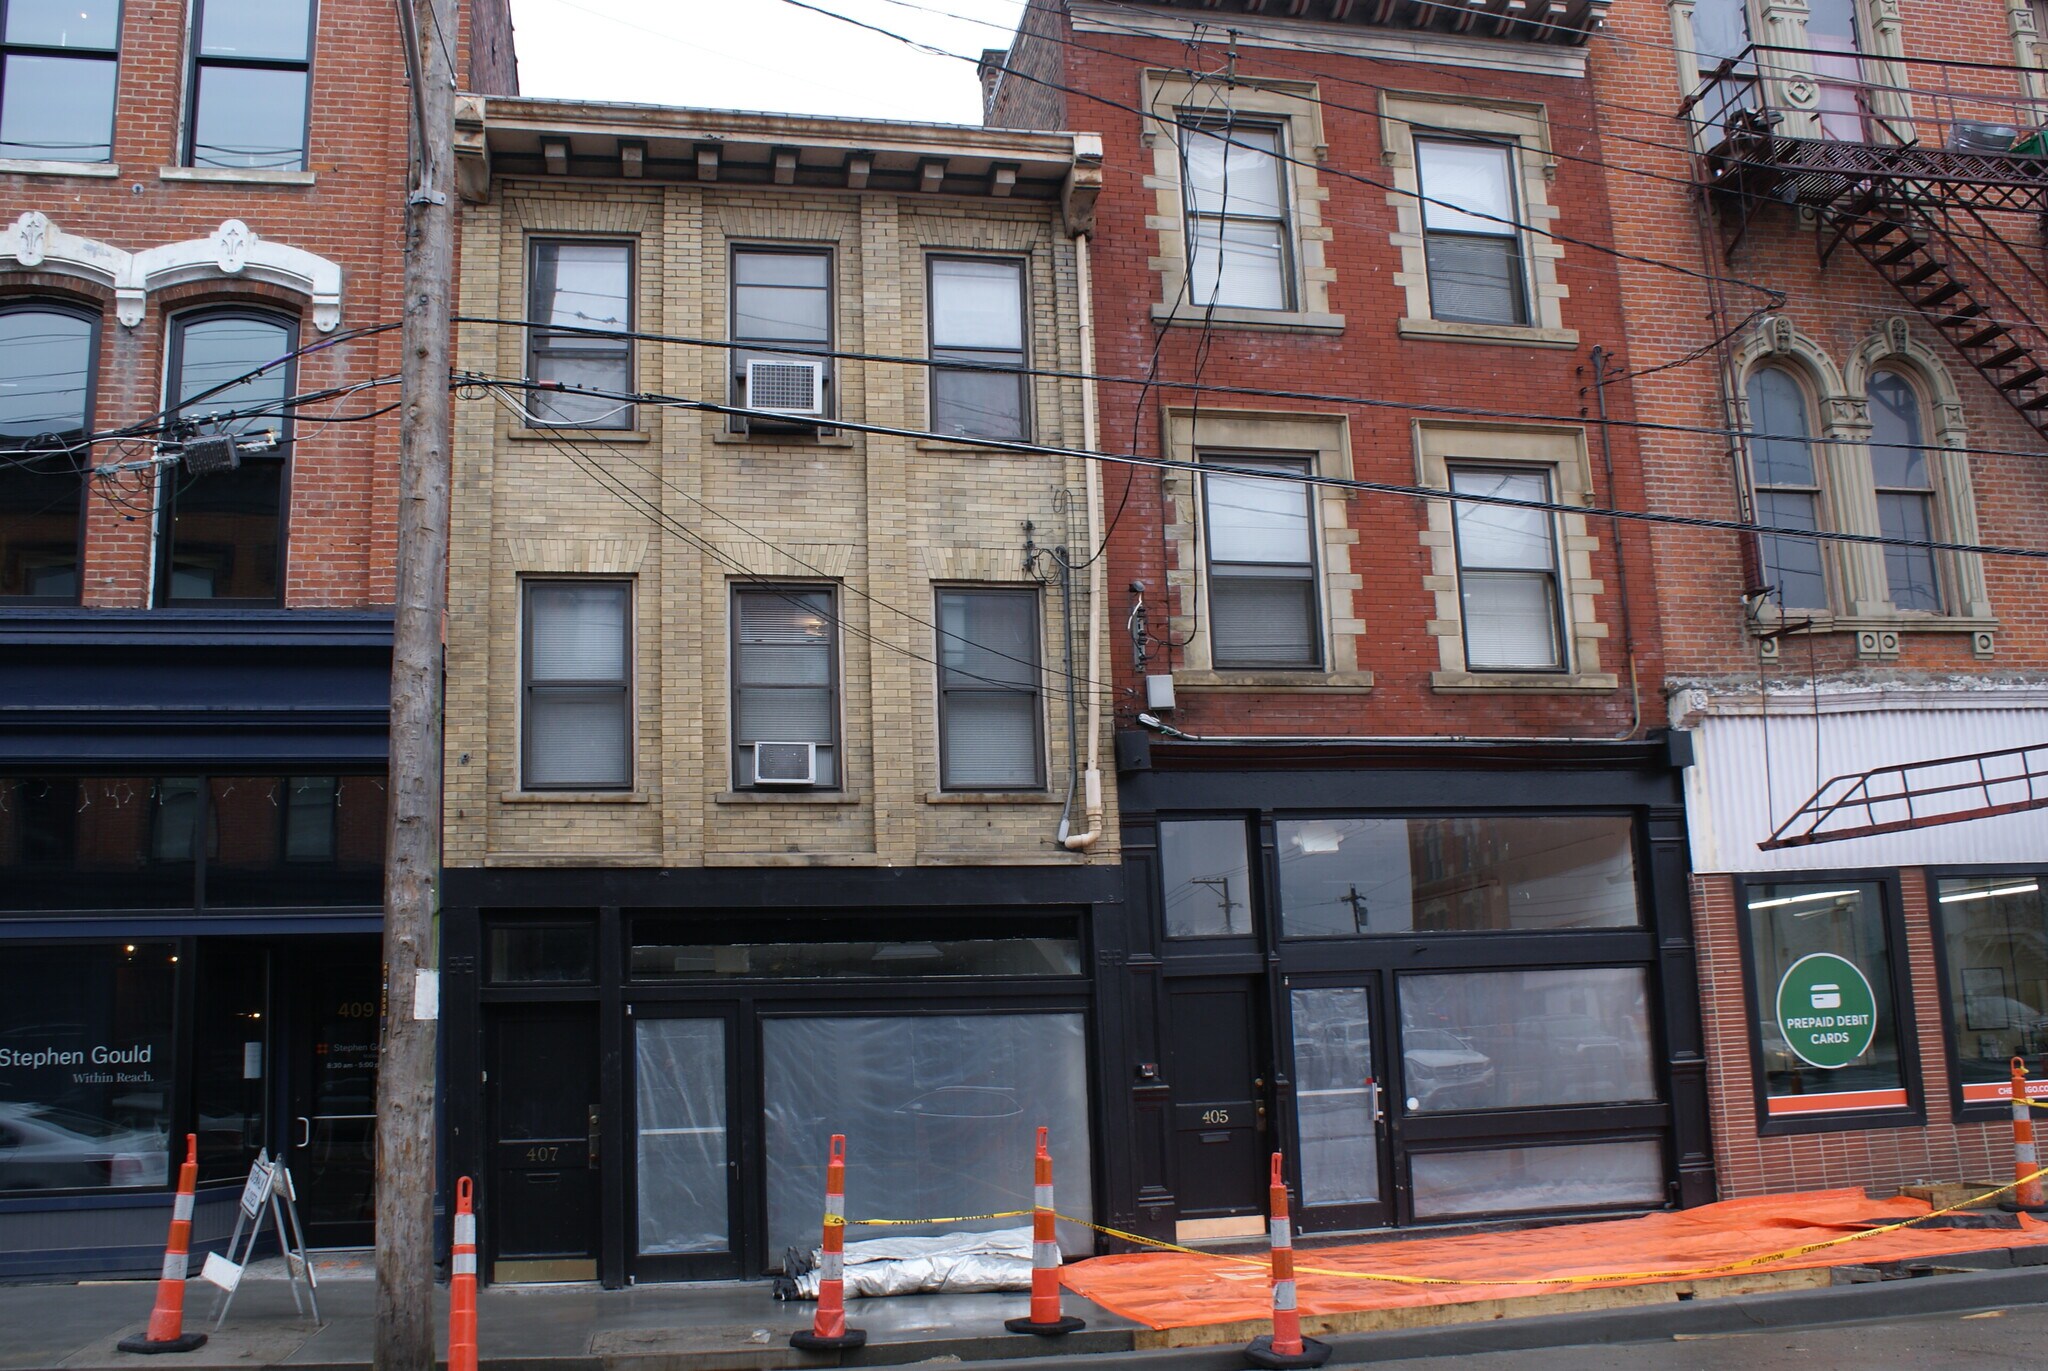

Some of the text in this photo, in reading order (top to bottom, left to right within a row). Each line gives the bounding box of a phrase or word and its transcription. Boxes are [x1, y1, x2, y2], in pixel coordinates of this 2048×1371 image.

[337, 1002, 374, 1018] 409
[1787, 1014, 1869, 1029] PREPAID DEBIT
[1811, 1032, 1850, 1044] CARDS
[334, 1043, 368, 1053] Stephen
[0, 1044, 152, 1069] Stephen Gould
[73, 1071, 155, 1083] Within Reach.
[1202, 1109, 1229, 1124] 405
[526, 1146, 559, 1162] 407
[1750, 1253, 1785, 1265] CAUTION
[1800, 1242, 1835, 1254] CAUTION
